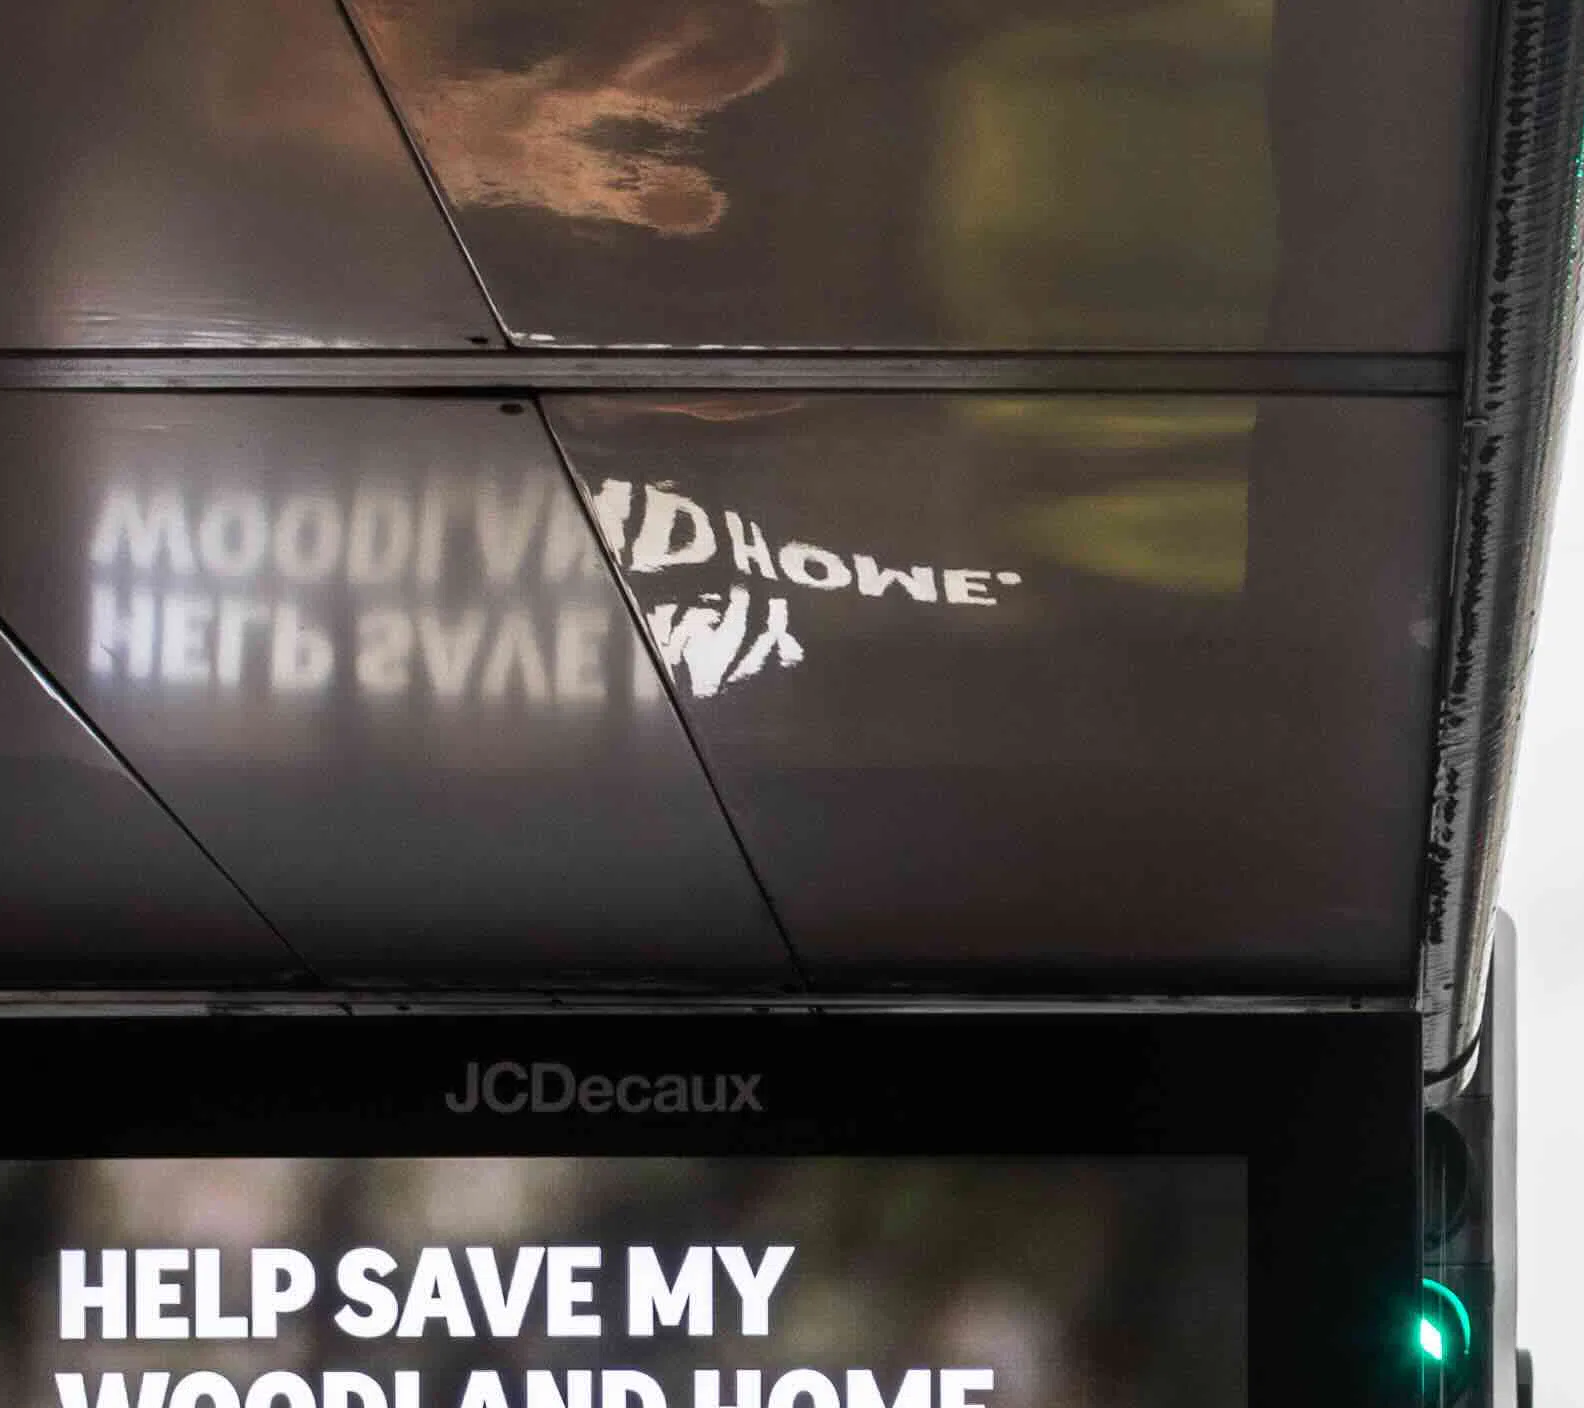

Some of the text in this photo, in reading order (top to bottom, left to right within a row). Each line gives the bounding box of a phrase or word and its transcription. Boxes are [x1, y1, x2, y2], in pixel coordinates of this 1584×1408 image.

[445, 1060, 764, 1116] JCDecaux
[59, 1245, 796, 1340] HELP SAVE MY
